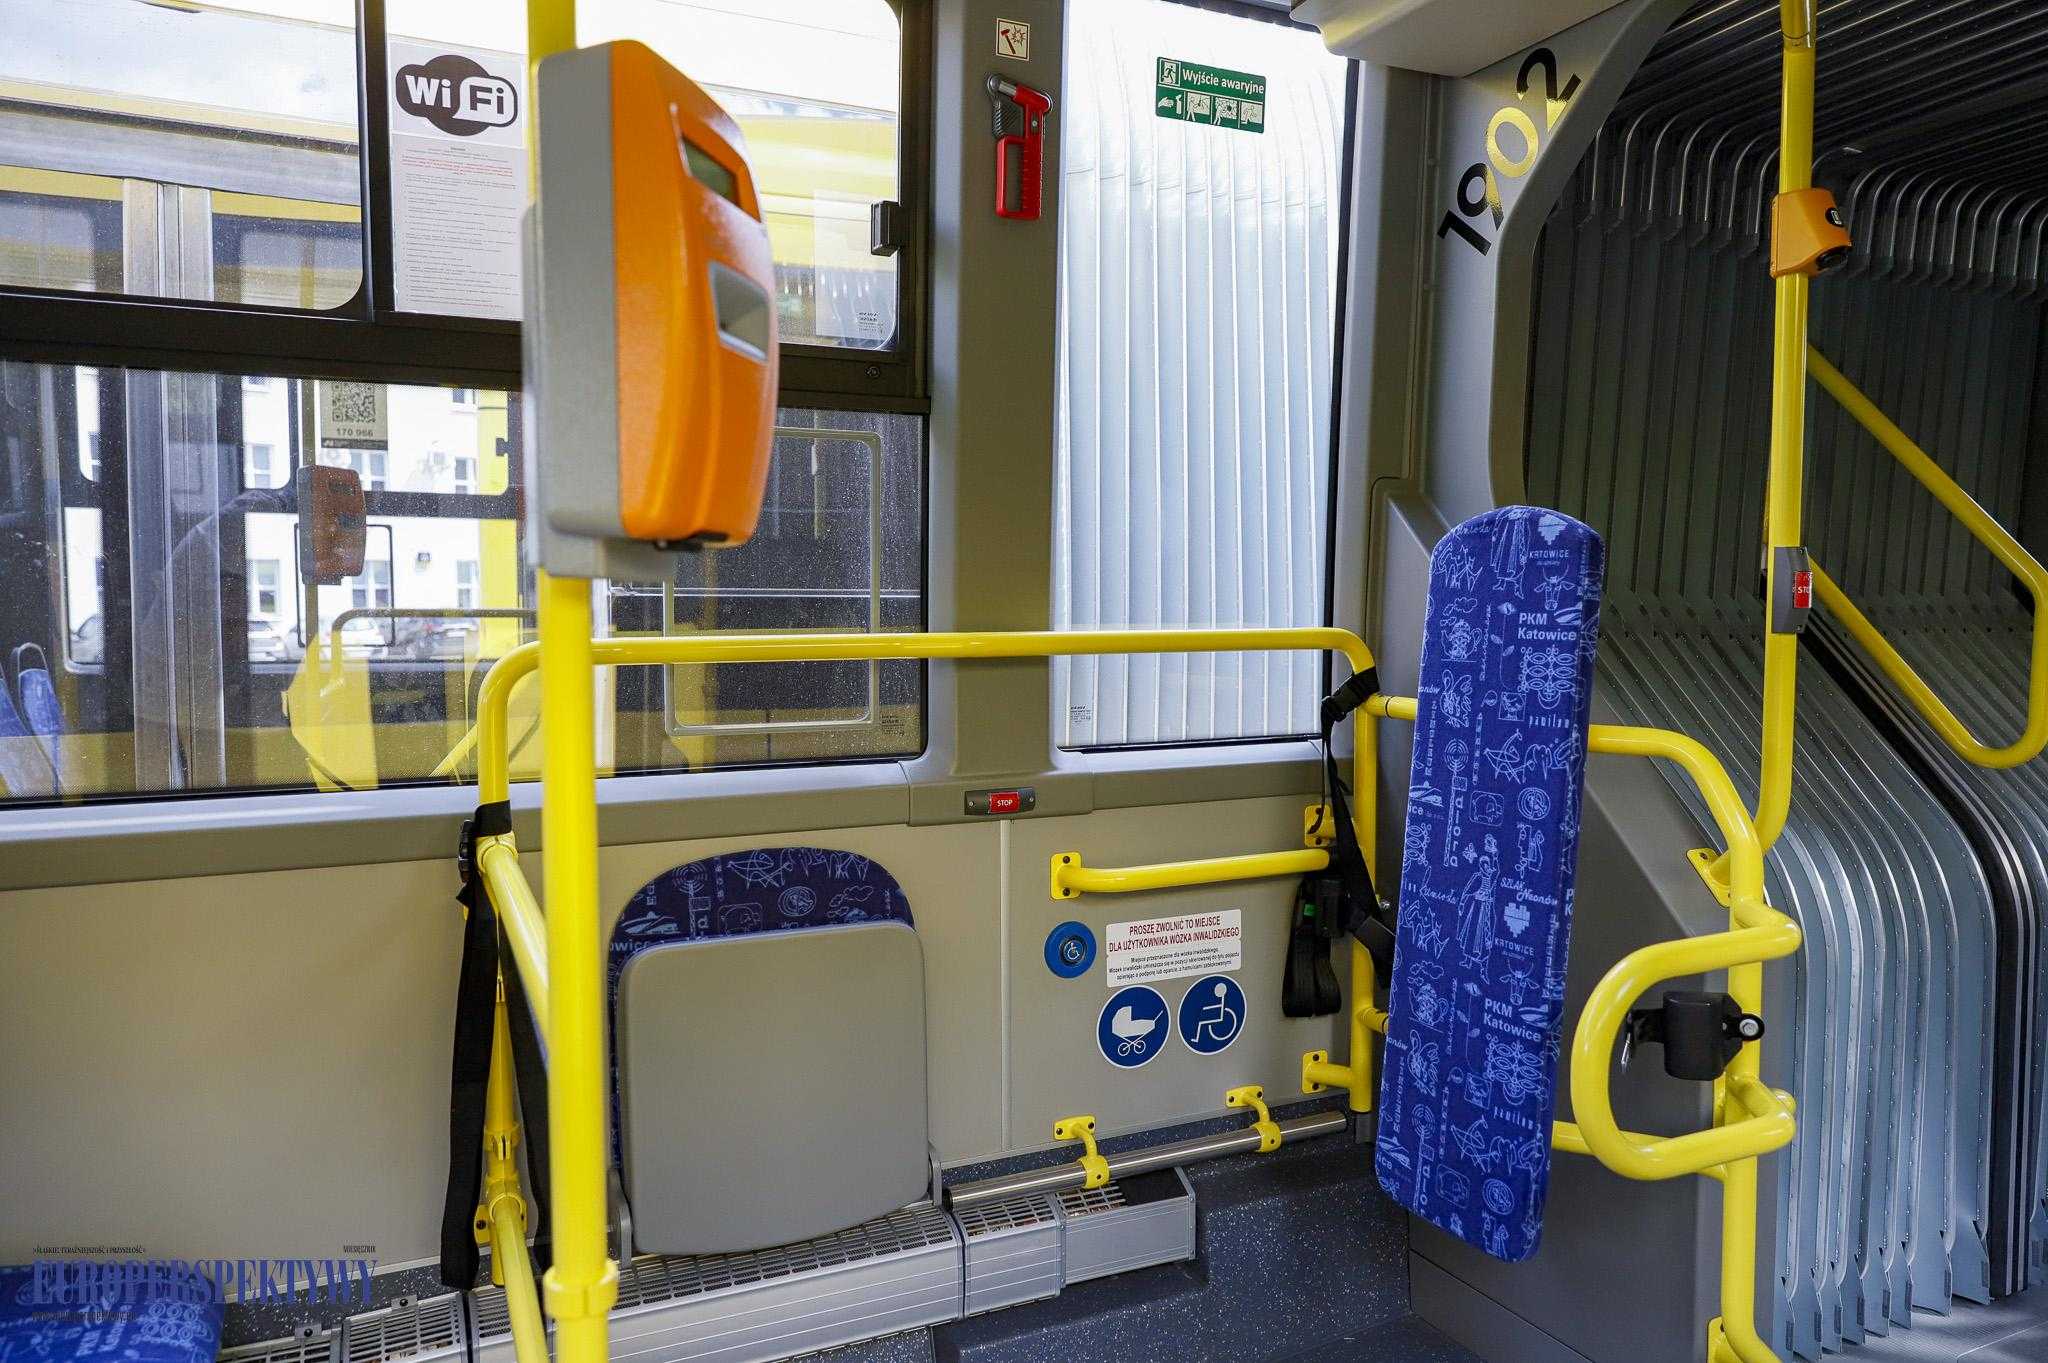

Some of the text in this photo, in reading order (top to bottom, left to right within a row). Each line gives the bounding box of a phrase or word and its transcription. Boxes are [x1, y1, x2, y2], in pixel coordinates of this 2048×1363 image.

[1182, 68, 1264, 94] Wyjście awaryjne
[1437, 47, 1582, 256] 1902
[1519, 613, 1547, 625] PKM
[1517, 628, 1577, 641] Katowice
[997, 799, 1013, 807] STOP
[1129, 915, 1220, 936] PROSZĘ ZWOLNIĆ TO MIEJSCE
[1109, 926, 1239, 952] DLA UŻYTKOWNIKA WÓZKA INWALIDZKIEGO
[1485, 999, 1513, 1018] PKM
[1484, 1013, 1541, 1042] Katowice
